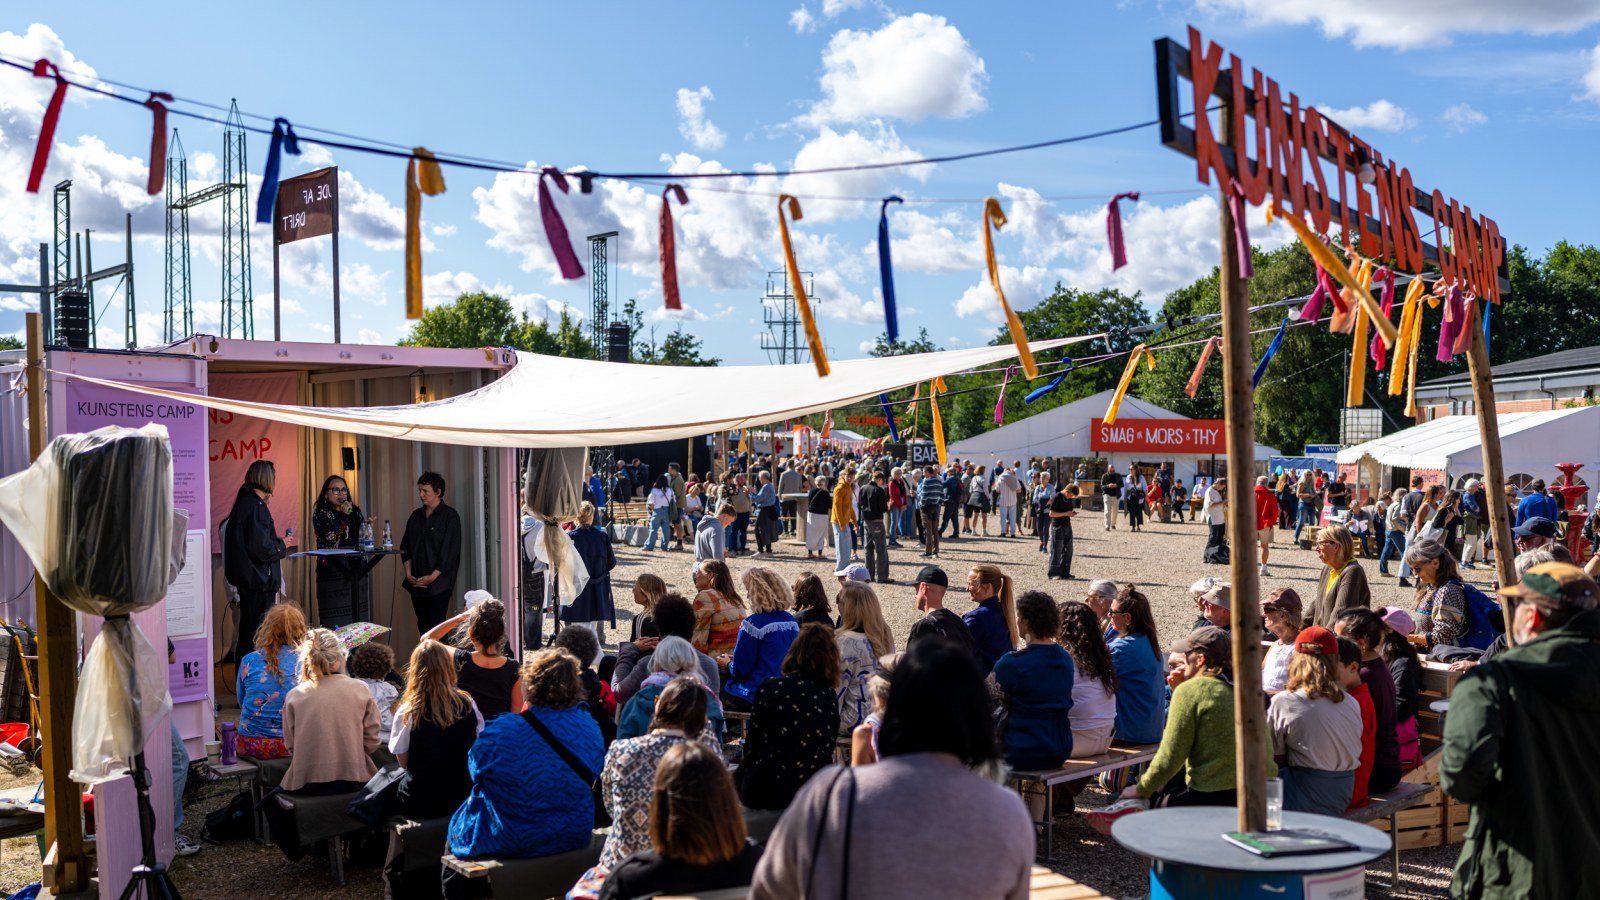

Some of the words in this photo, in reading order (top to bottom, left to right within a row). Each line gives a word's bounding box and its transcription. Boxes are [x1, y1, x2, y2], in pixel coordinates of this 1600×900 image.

[1187, 24, 1423, 274] KUNSTENS
[1432, 188, 1503, 305] CAMP
[77, 401, 154, 418] KUNSTENS
[156, 404, 195, 420] CAMP
[848, 415, 902, 427] VILDNISST
[1101, 427, 1135, 444] SMAG
[1145, 427, 1183, 444] MORS
[1192, 428, 1219, 445] THY
[209, 437, 272, 462] CAMP
[913, 446, 938, 462] BAR
